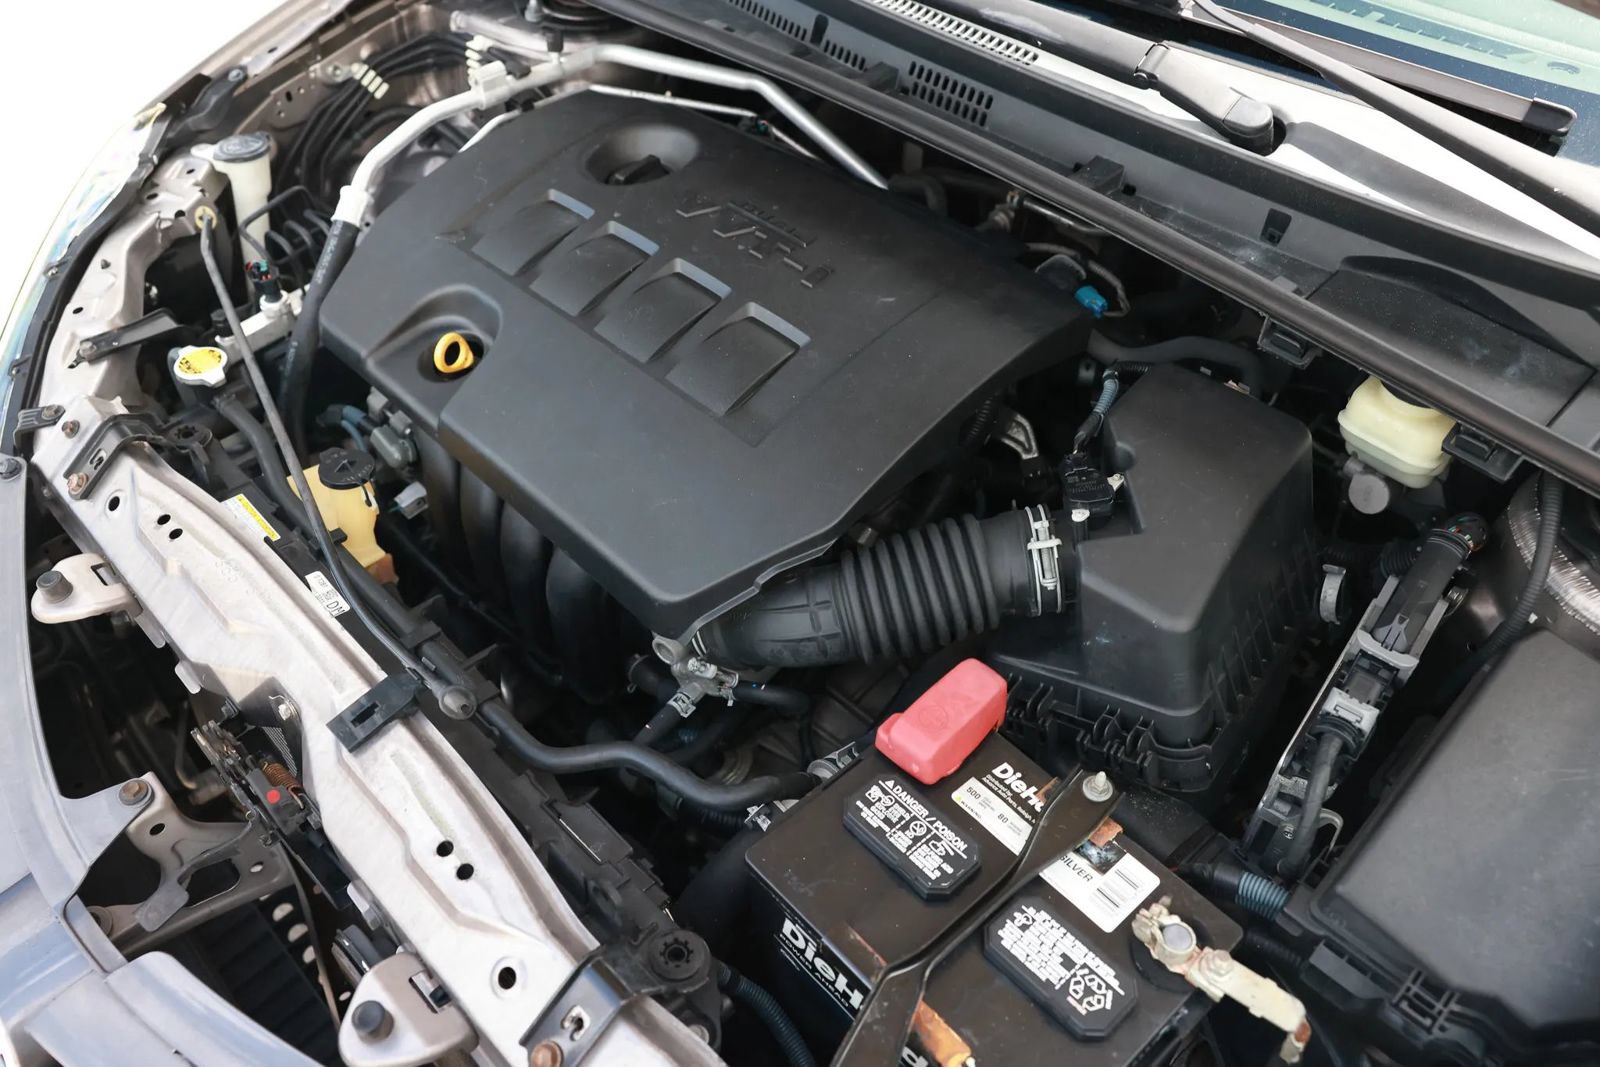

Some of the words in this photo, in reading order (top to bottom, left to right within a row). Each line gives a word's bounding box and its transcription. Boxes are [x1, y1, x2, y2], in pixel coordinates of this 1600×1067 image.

[965, 786, 981, 800] 500
[892, 784, 929, 817] DANGER
[932, 820, 968, 851] POISON
[1060, 855, 1093, 882] SILVER
[779, 933, 812, 970] POWER
[815, 971, 849, 1007] AHEAD
